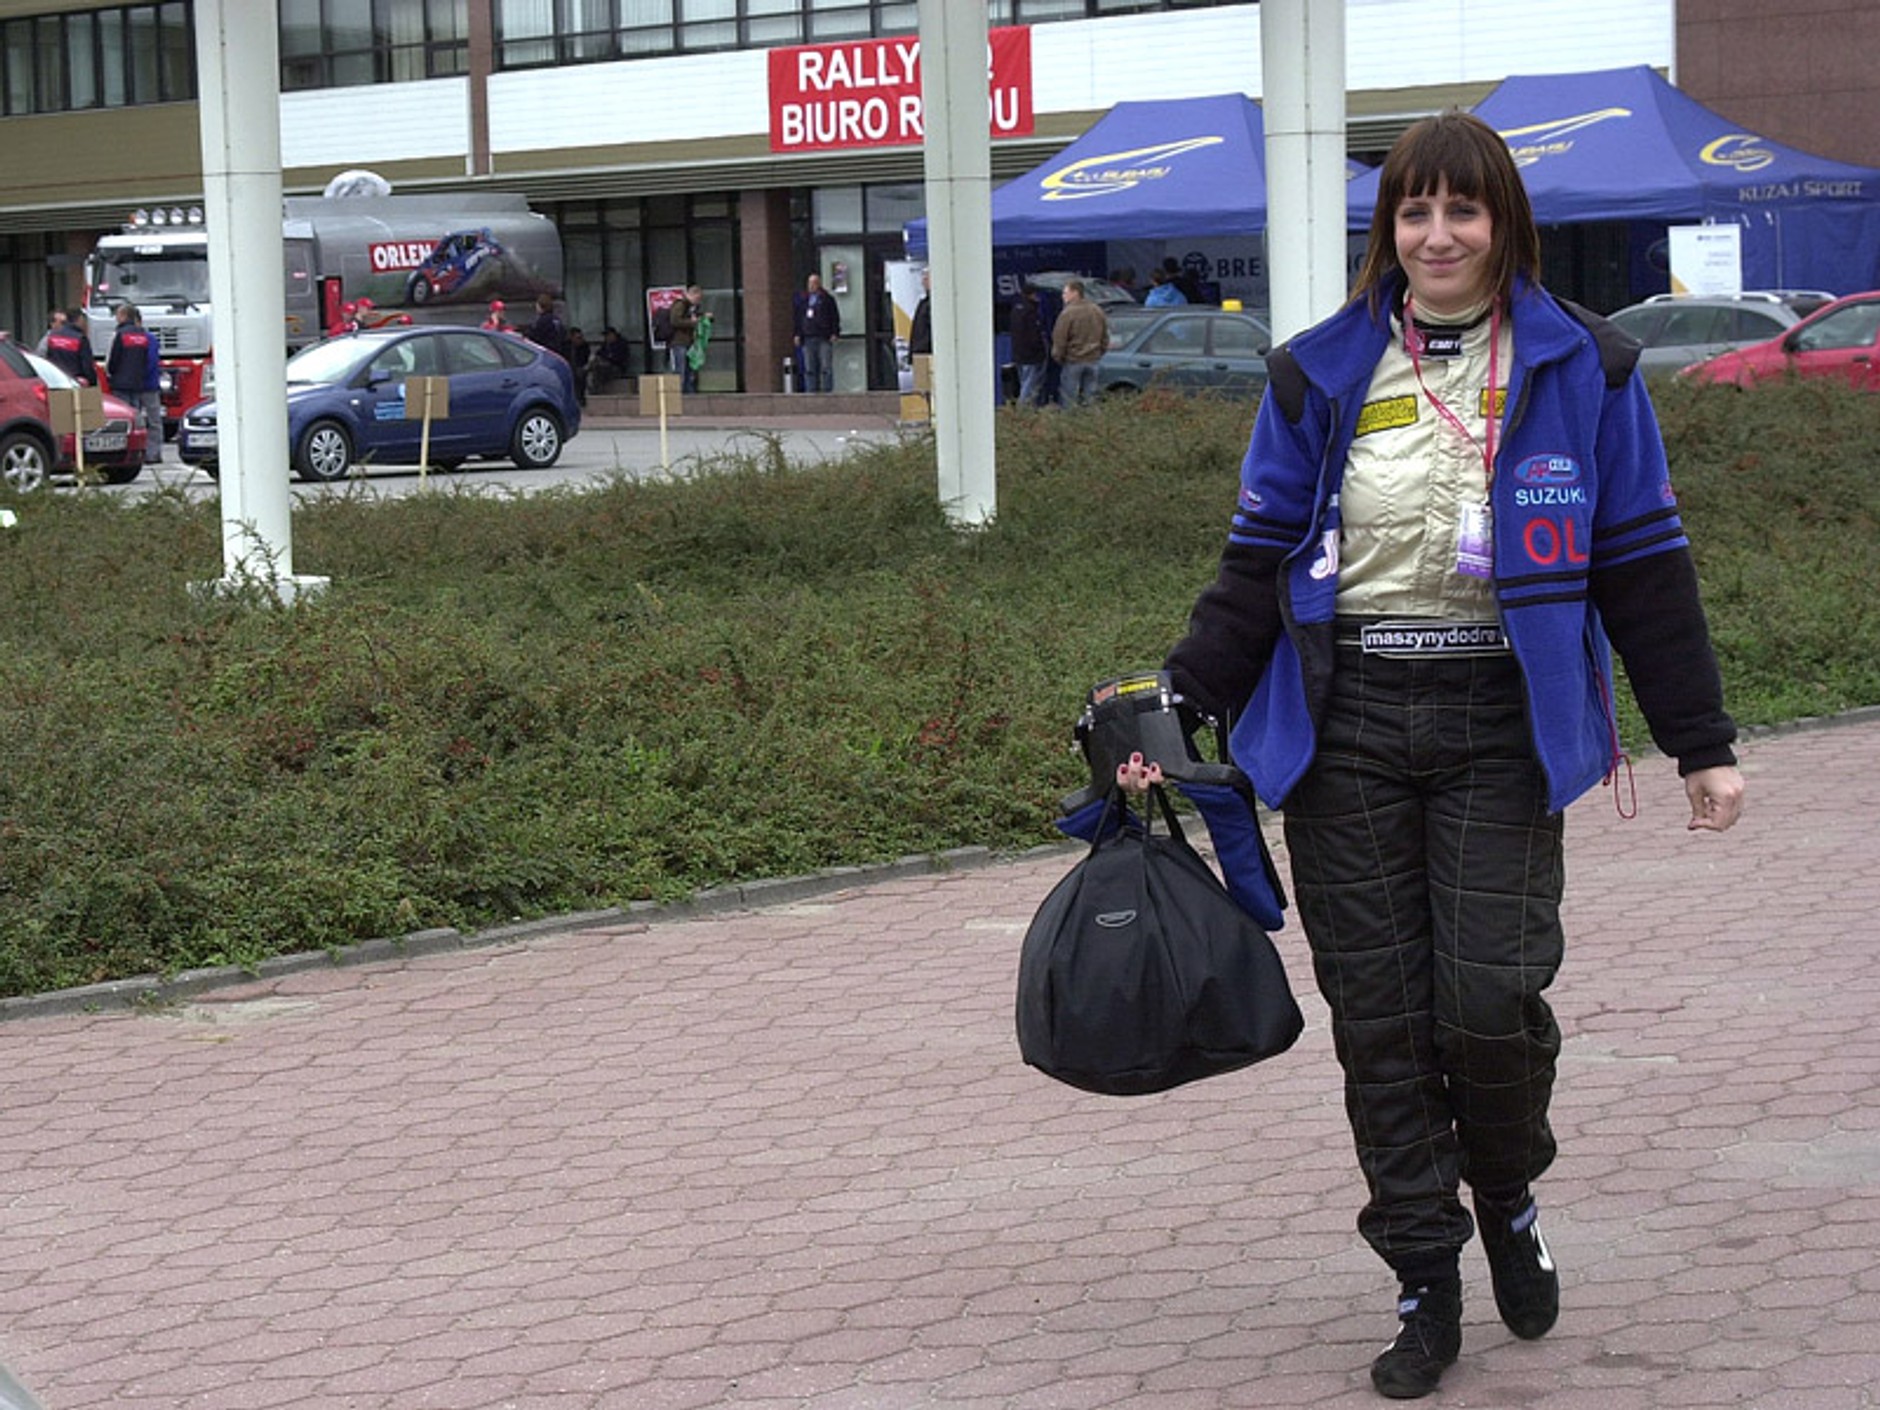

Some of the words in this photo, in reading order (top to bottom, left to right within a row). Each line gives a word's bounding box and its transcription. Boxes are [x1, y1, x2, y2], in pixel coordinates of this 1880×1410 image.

[798, 43, 921, 92] RALLY
[782, 97, 890, 145] BIURO
[1738, 183, 1800, 201] KUZAJ
[1803, 180, 1864, 197] SPORT
[373, 243, 432, 269] ORLEN
